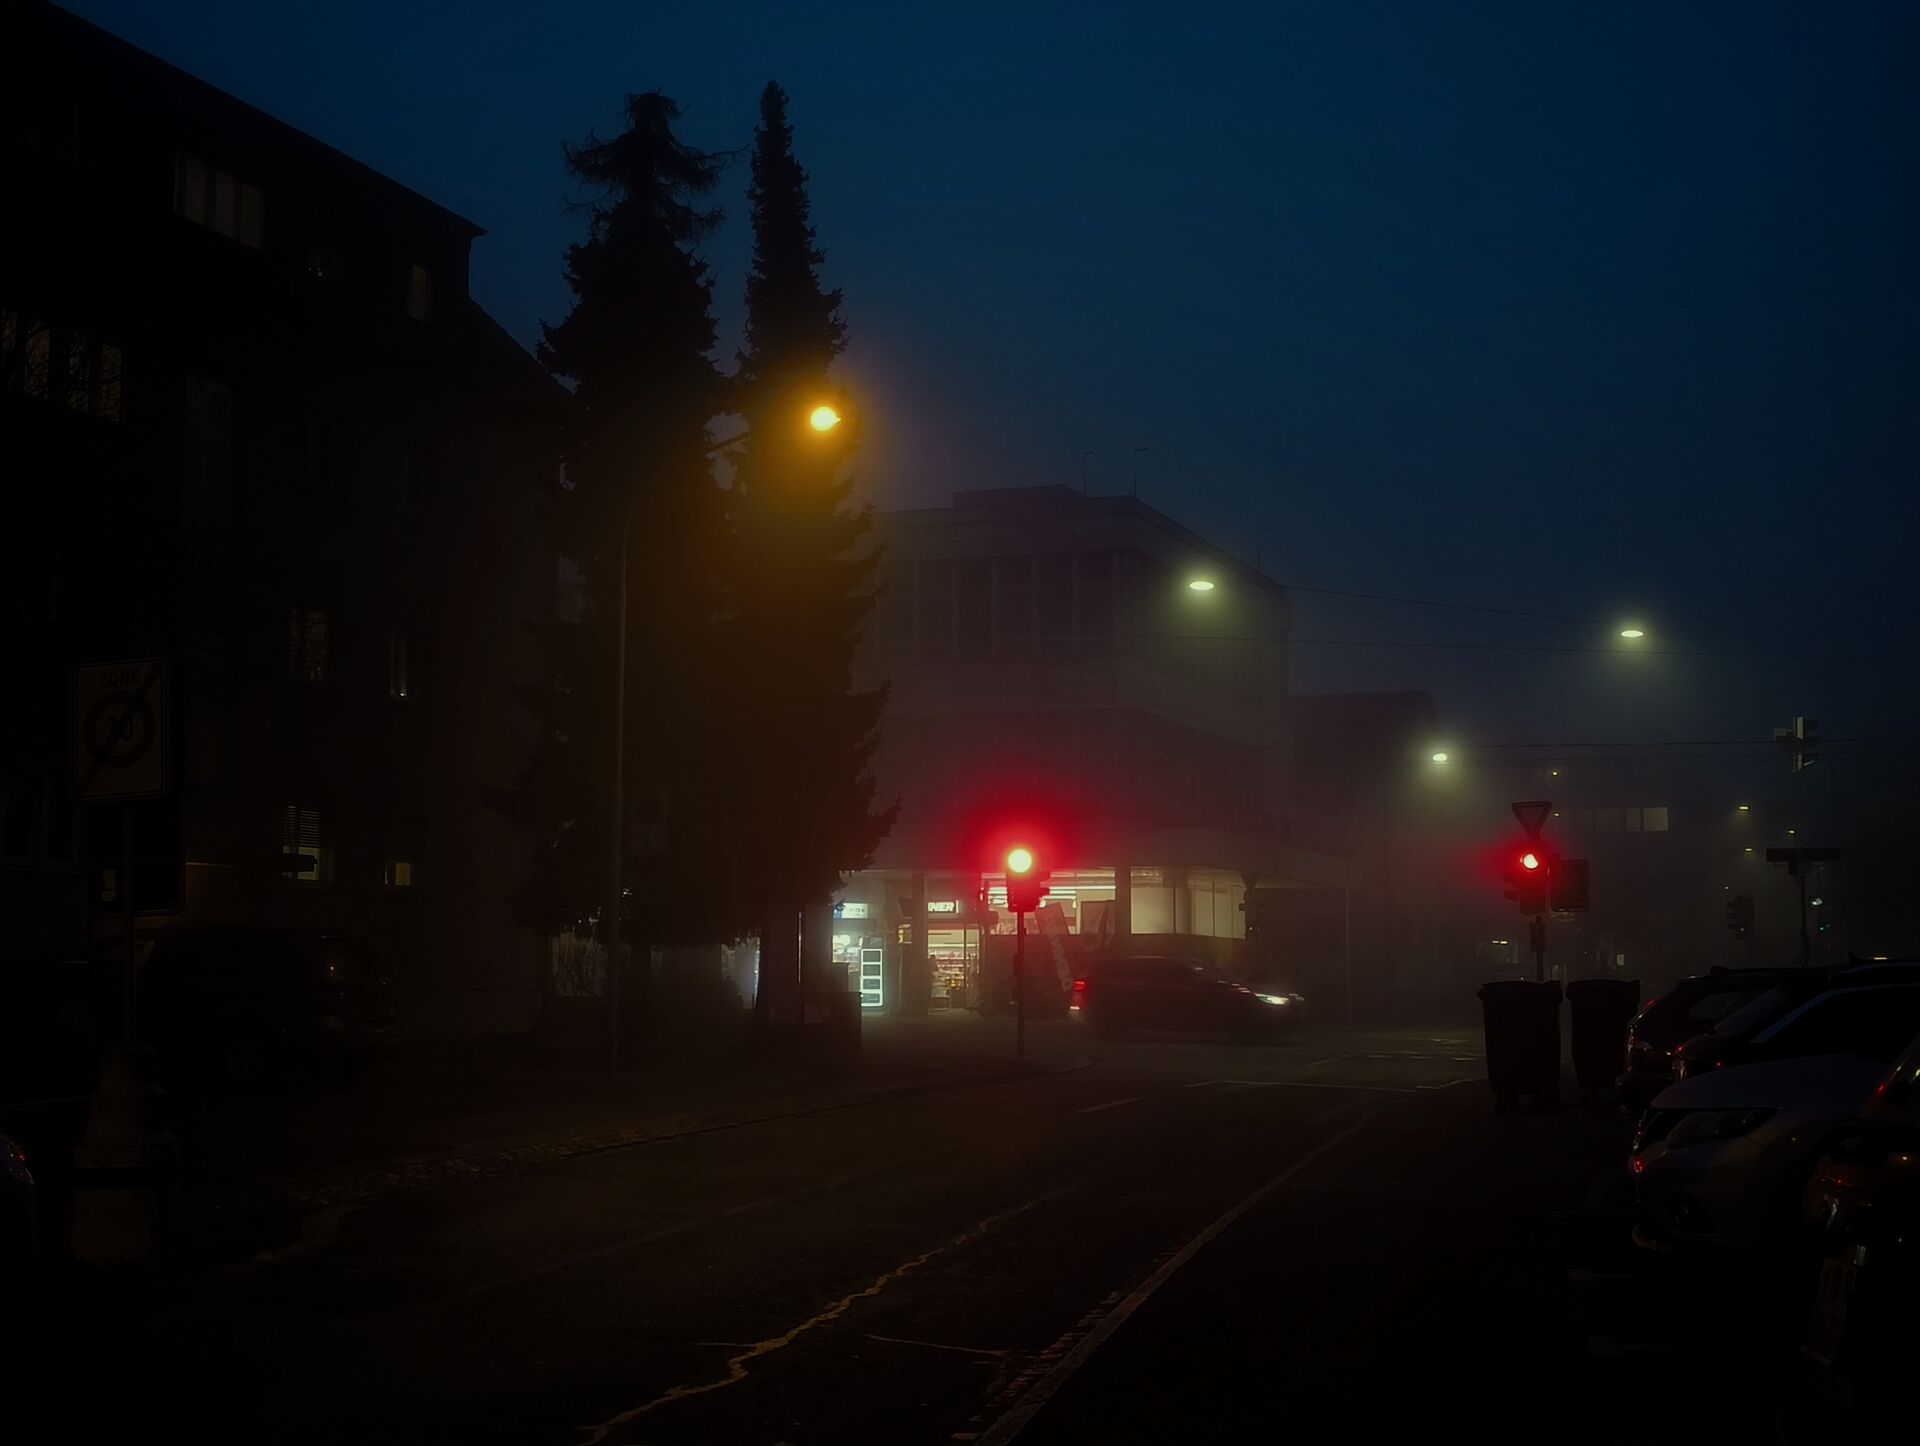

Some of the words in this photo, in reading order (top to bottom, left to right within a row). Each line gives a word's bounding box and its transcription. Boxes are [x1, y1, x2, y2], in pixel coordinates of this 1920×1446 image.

[98, 669, 140, 687] ZONE
[106, 712, 133, 744] 30
[928, 902, 954, 911] NER
